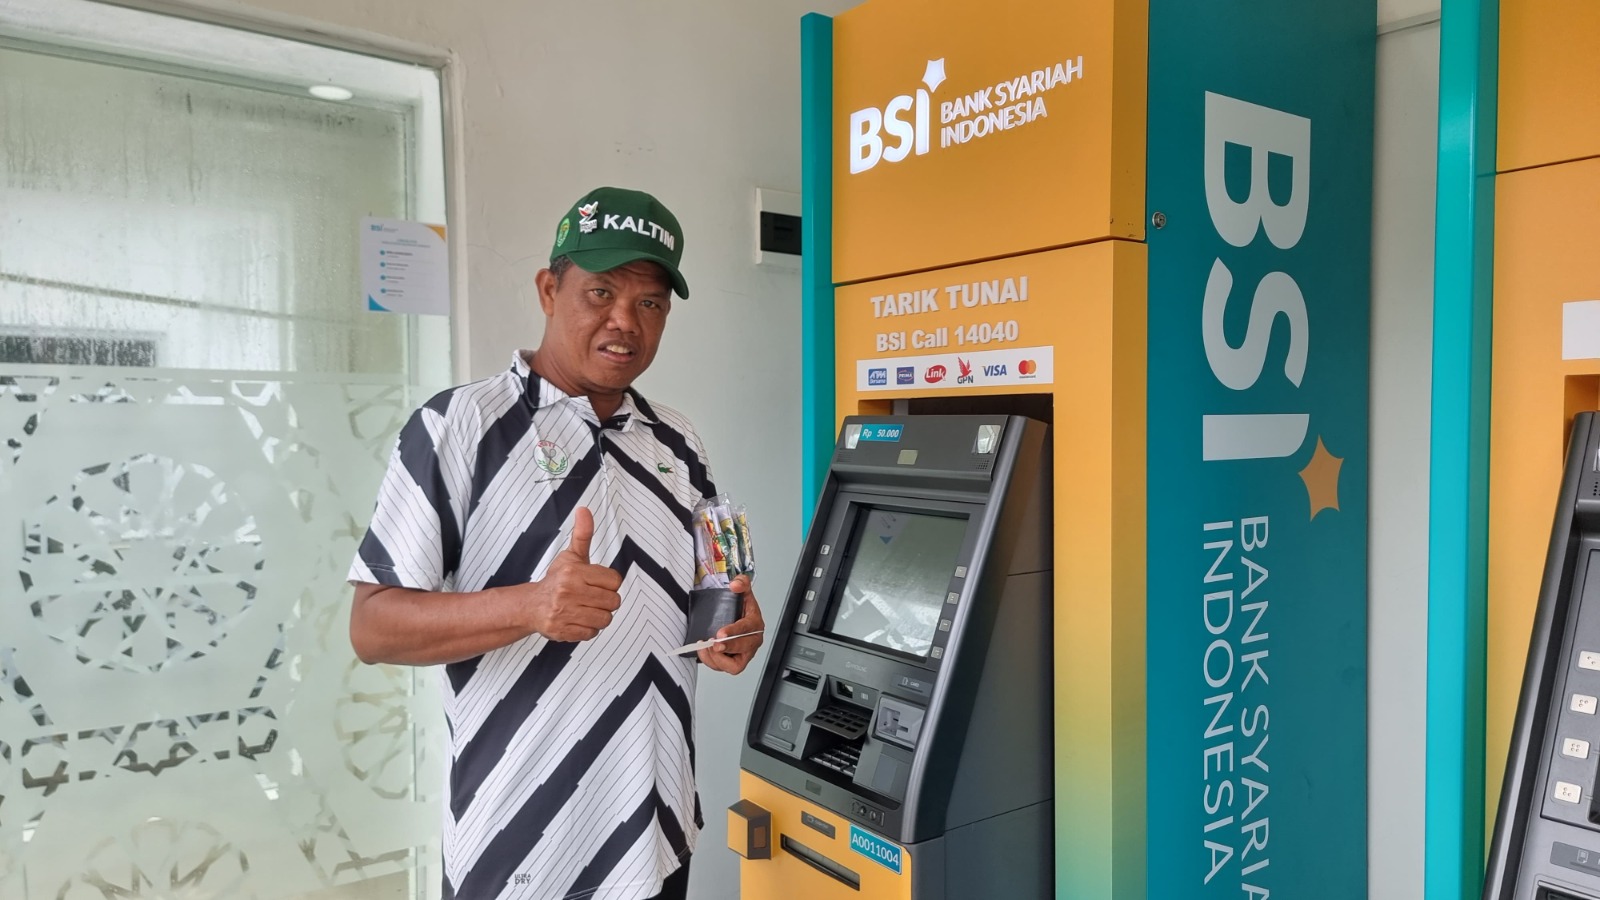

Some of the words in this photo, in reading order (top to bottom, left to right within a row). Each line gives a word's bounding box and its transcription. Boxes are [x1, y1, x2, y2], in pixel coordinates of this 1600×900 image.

[941, 86, 992, 124] BANK
[995, 55, 1083, 104] SYARIAH
[850, 88, 930, 174] BSI
[941, 97, 1047, 148] INDONESIA
[603, 214, 675, 251] KALTIM
[1202, 91, 1311, 461] BSI
[870, 288, 940, 318] TARIK
[945, 276, 1028, 310] TUNAI
[876, 331, 906, 352] BSI
[912, 327, 948, 349] Call
[954, 320, 1019, 346] 14040
[926, 368, 945, 379] Link
[957, 375, 974, 384] GPN
[983, 364, 1007, 376] VISA
[862, 429, 872, 438] Rp
[877, 429, 899, 438] 50.000
[1241, 515, 1269, 693] BANK
[1203, 520, 1234, 885] INDONESIA
[851, 833, 899, 866] A0011004
